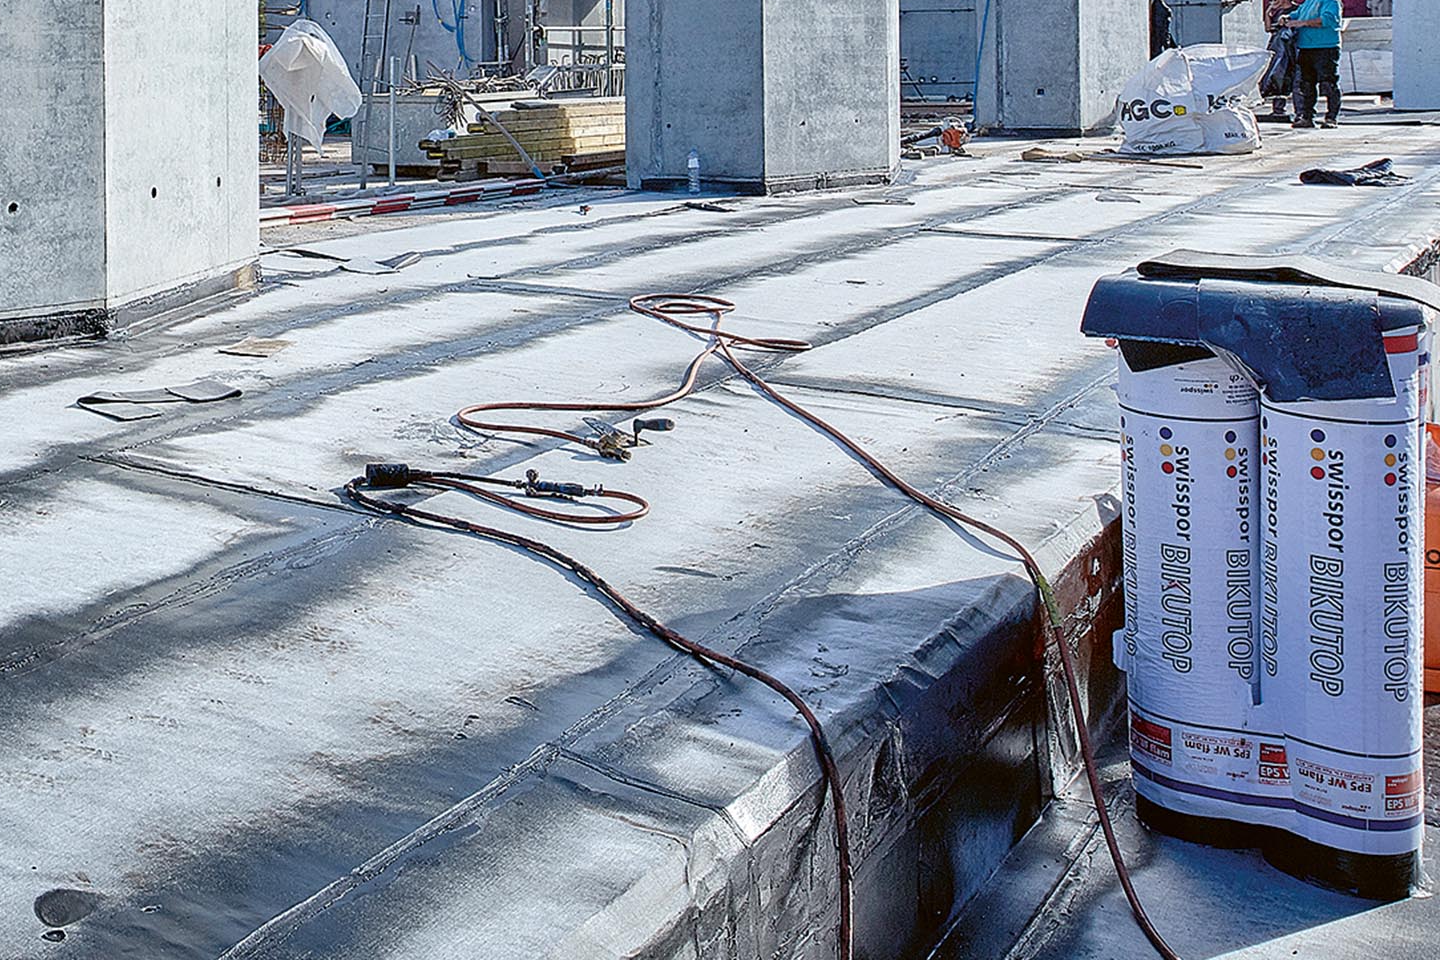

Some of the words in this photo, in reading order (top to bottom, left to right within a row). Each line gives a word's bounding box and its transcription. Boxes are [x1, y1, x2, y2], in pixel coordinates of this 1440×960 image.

[1171, 446, 1195, 542] swisspor
[1235, 447, 1252, 543] swisspor
[1266, 437, 1282, 539] swisspor
[1323, 450, 1350, 554] swisspor
[1394, 452, 1411, 555] swisspor
[1160, 543, 1192, 674] BIKUTOP
[1226, 549, 1254, 680] BIKUTOP
[1310, 554, 1344, 697] BIKUTOP
[1383, 562, 1409, 702] BIKUTOP
[1260, 766, 1281, 778] EPS
[1350, 781, 1372, 793] EPS
